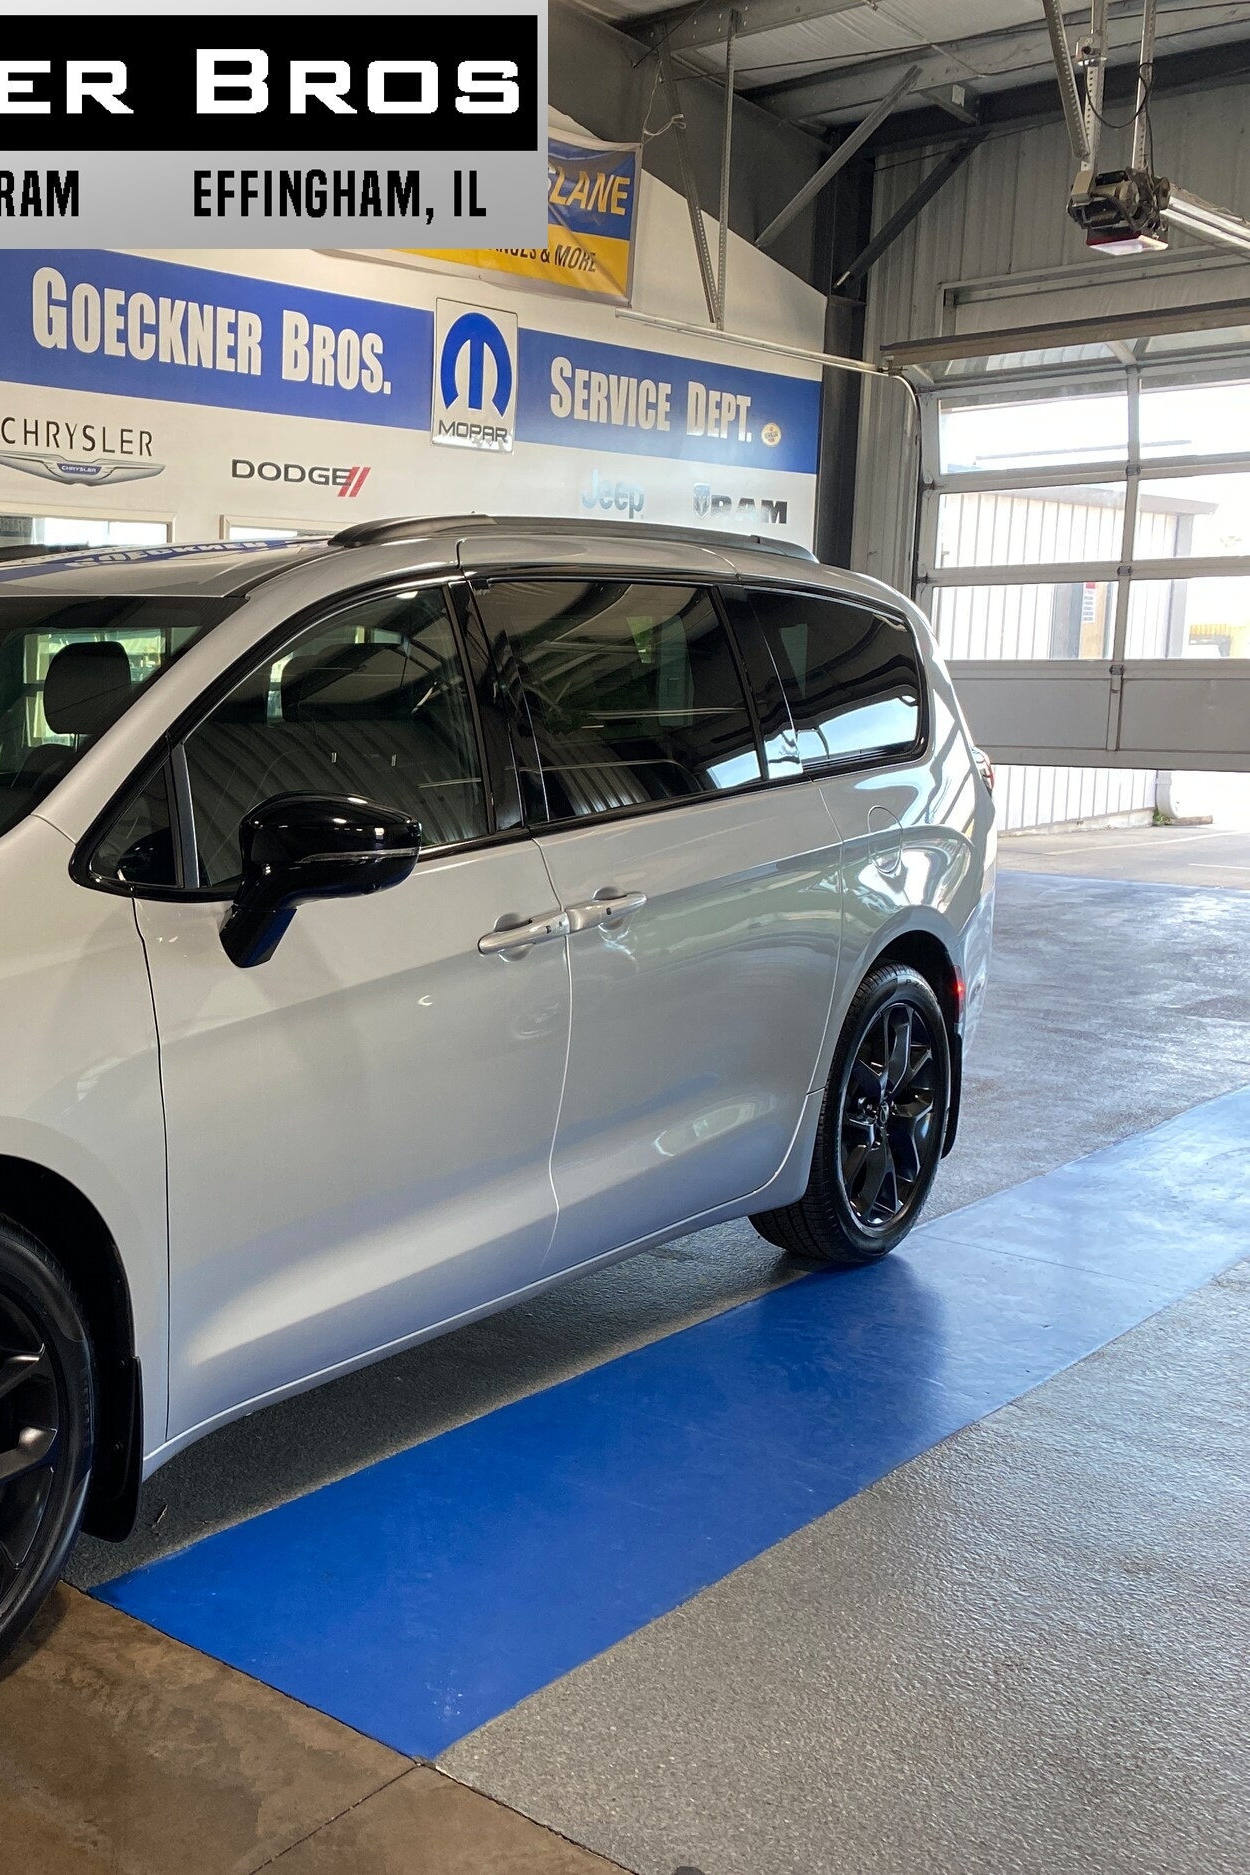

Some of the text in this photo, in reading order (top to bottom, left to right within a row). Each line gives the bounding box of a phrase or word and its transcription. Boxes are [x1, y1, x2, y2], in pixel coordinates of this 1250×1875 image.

[554, 244, 596, 272] MORE
[31, 266, 392, 395] GOECKNER BROS.
[550, 356, 752, 443] SERVICE DEPT.
[0, 416, 154, 457] CHRYSLER
[438, 419, 509, 444] MOPAR
[61, 465, 97, 473] CHRYSLER
[231, 459, 351, 488] DODGE
[581, 468, 645, 519] Jeep
[710, 494, 788, 524] RAM
